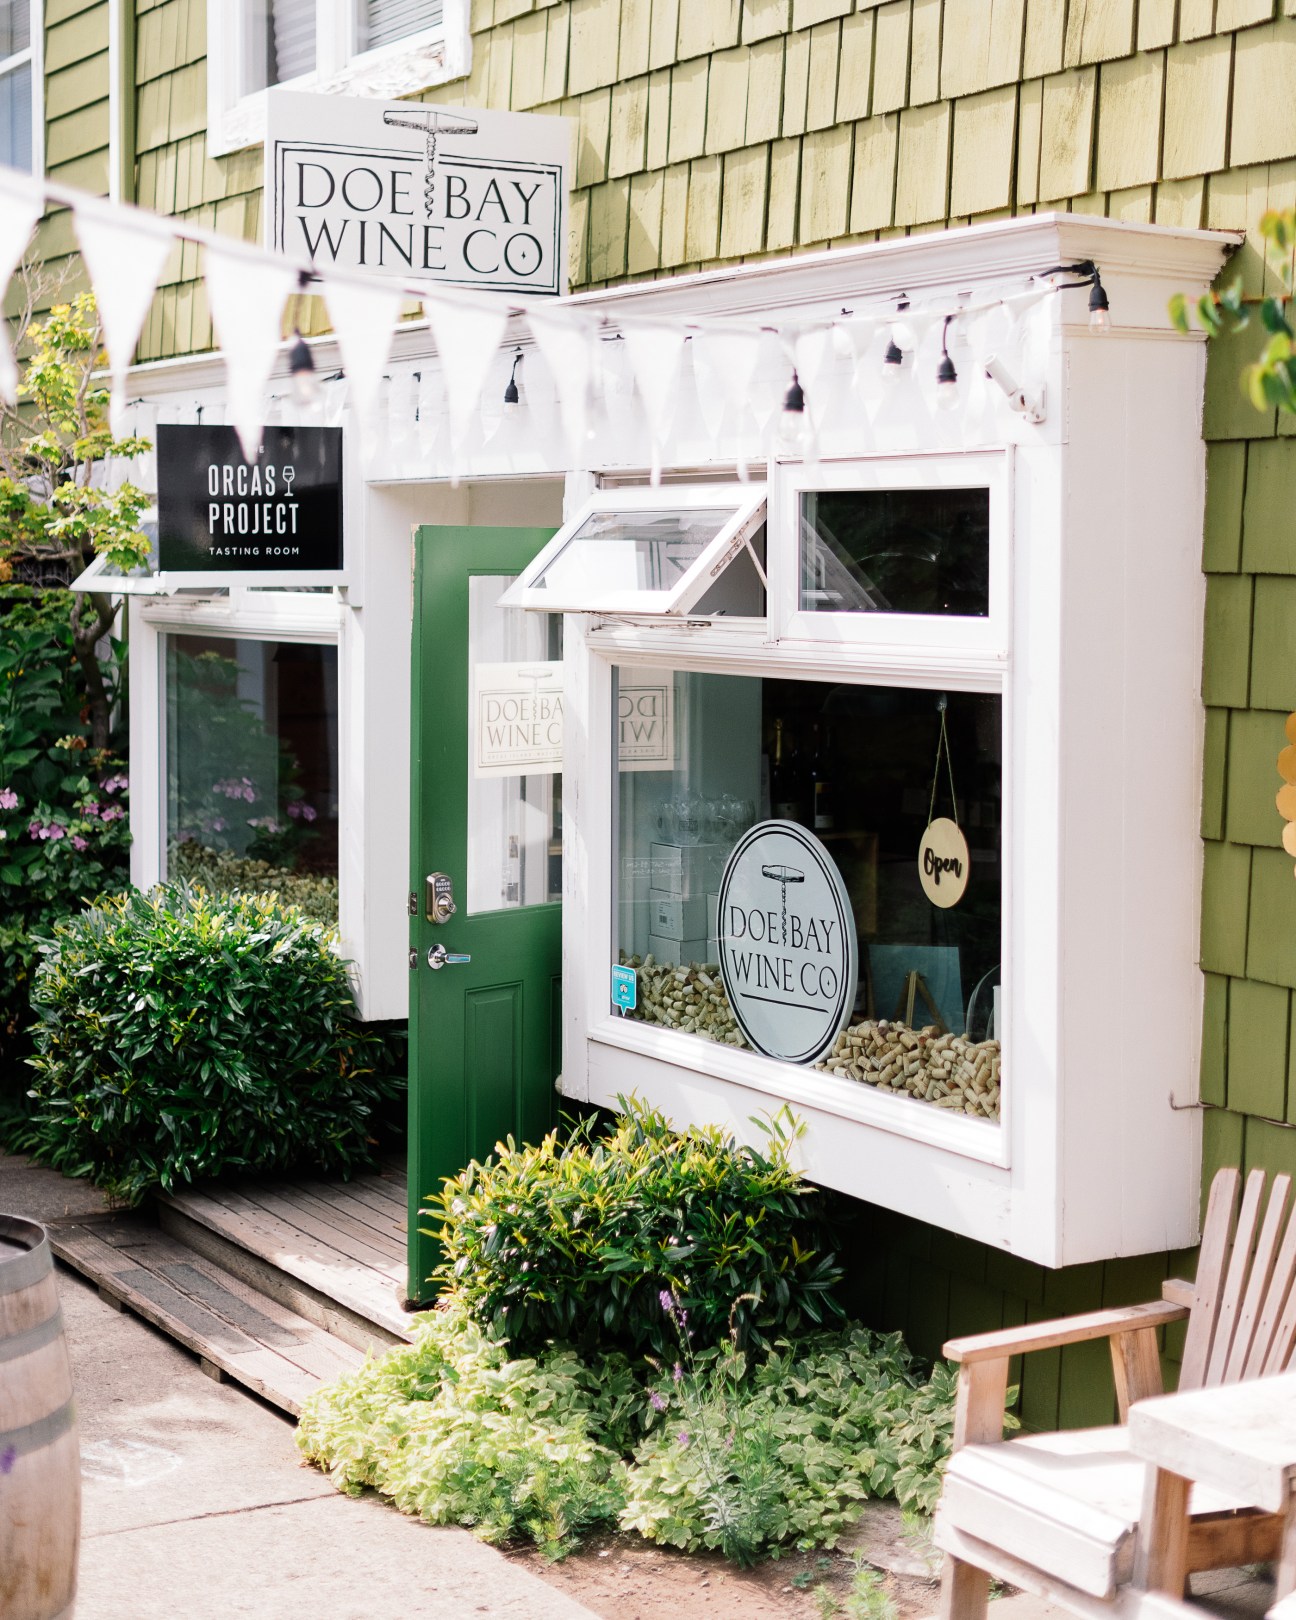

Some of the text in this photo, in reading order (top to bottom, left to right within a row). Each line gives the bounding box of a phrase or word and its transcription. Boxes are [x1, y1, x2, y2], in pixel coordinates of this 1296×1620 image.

[296, 162, 543, 225] DOE BAY
[298, 216, 543, 276] WINE CO
[208, 464, 276, 496] ORCAS
[209, 503, 299, 534] PROJECT
[209, 547, 299, 555] TASTING ROOM
[487, 697, 563, 722] DOE BA
[487, 724, 542, 748] WINE
[923, 847, 962, 885] Open
[730, 905, 836, 954] DOE BAY
[731, 949, 838, 999] WINE CO
